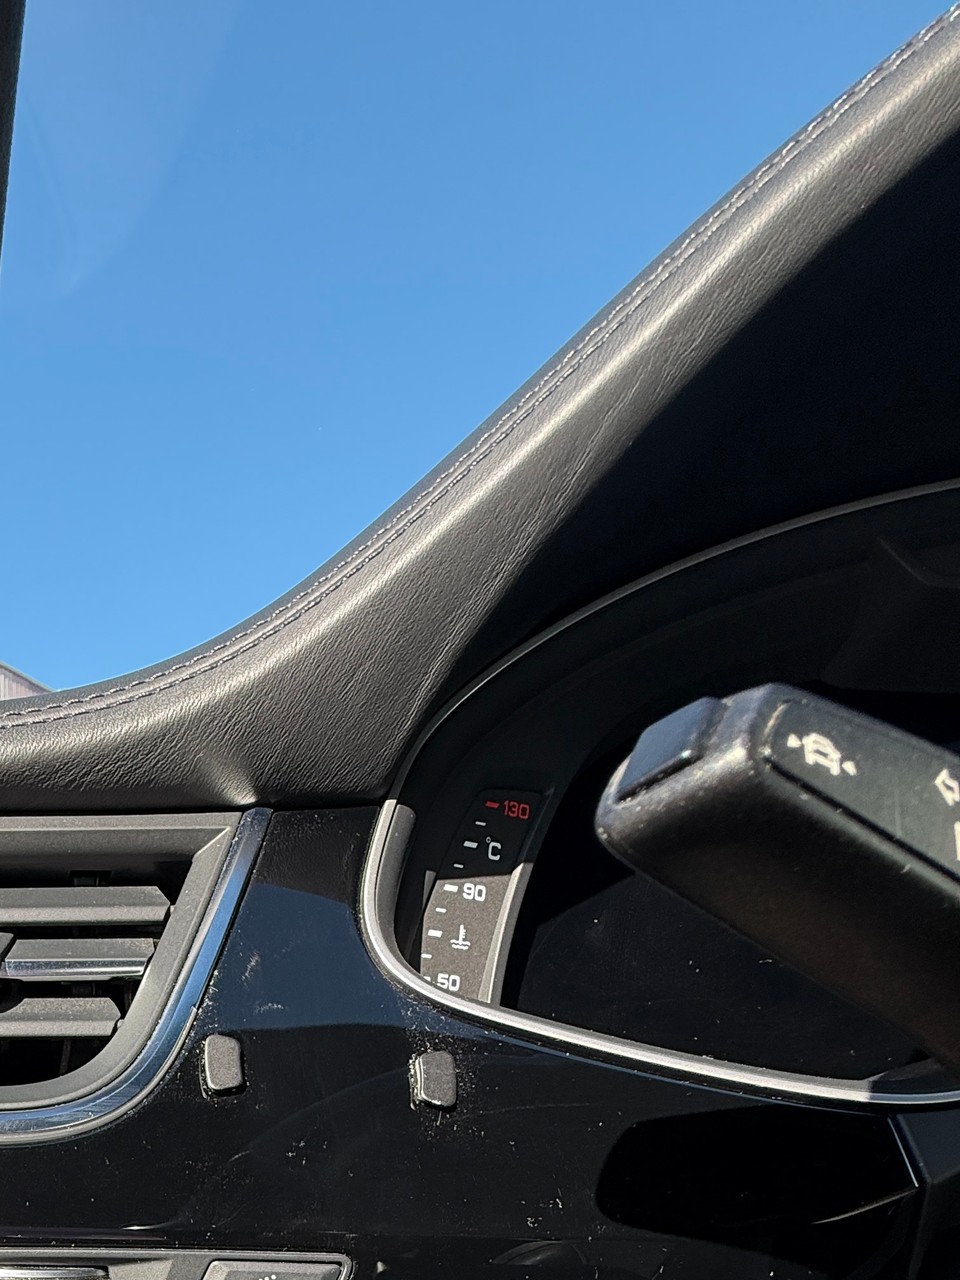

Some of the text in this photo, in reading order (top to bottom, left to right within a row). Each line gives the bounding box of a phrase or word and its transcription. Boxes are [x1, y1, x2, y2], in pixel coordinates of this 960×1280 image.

[503, 800, 530, 820] 130
[462, 882, 487, 902] 90
[436, 973, 461, 992] 50
